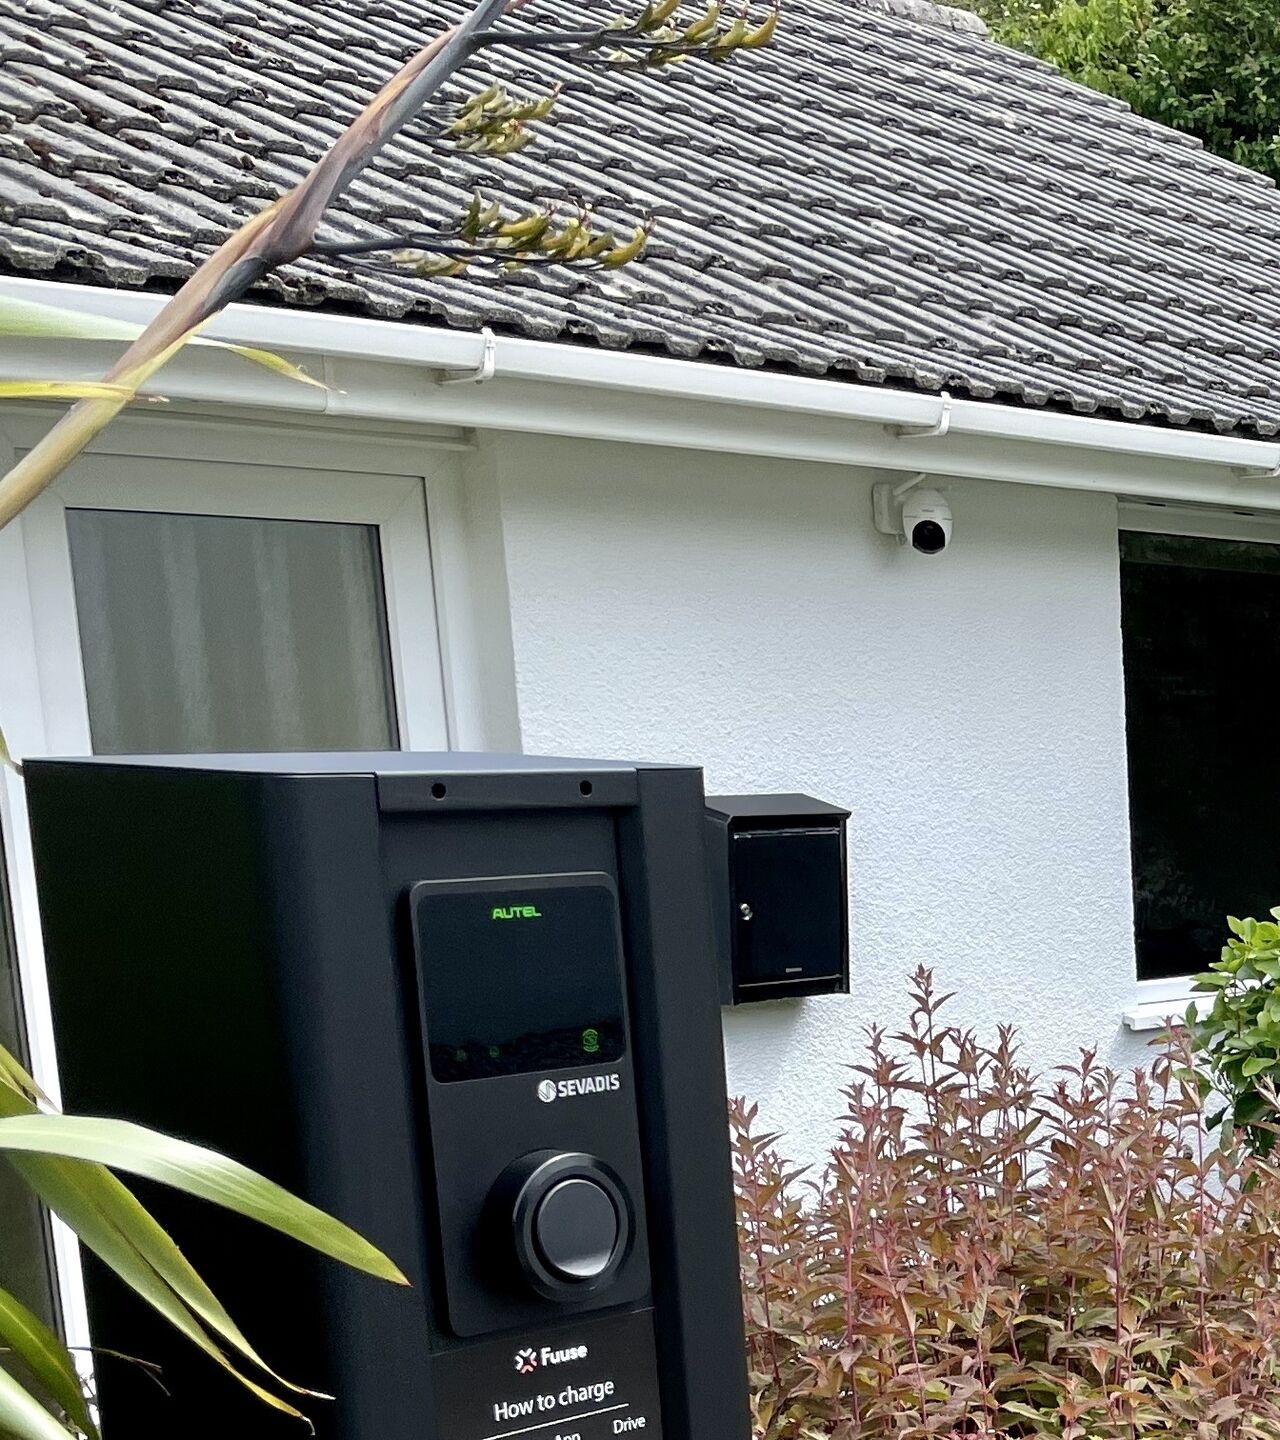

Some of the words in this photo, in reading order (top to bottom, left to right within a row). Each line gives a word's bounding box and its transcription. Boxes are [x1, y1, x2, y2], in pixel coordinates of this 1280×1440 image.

[492, 906, 542, 920] AUTEL
[557, 1073, 621, 1098] SEVADIS
[540, 1345, 588, 1366] Fuuse
[493, 1403, 534, 1422] How
[536, 1394, 556, 1411] to
[558, 1381, 615, 1406] charge
[612, 1415, 646, 1434] Drive
